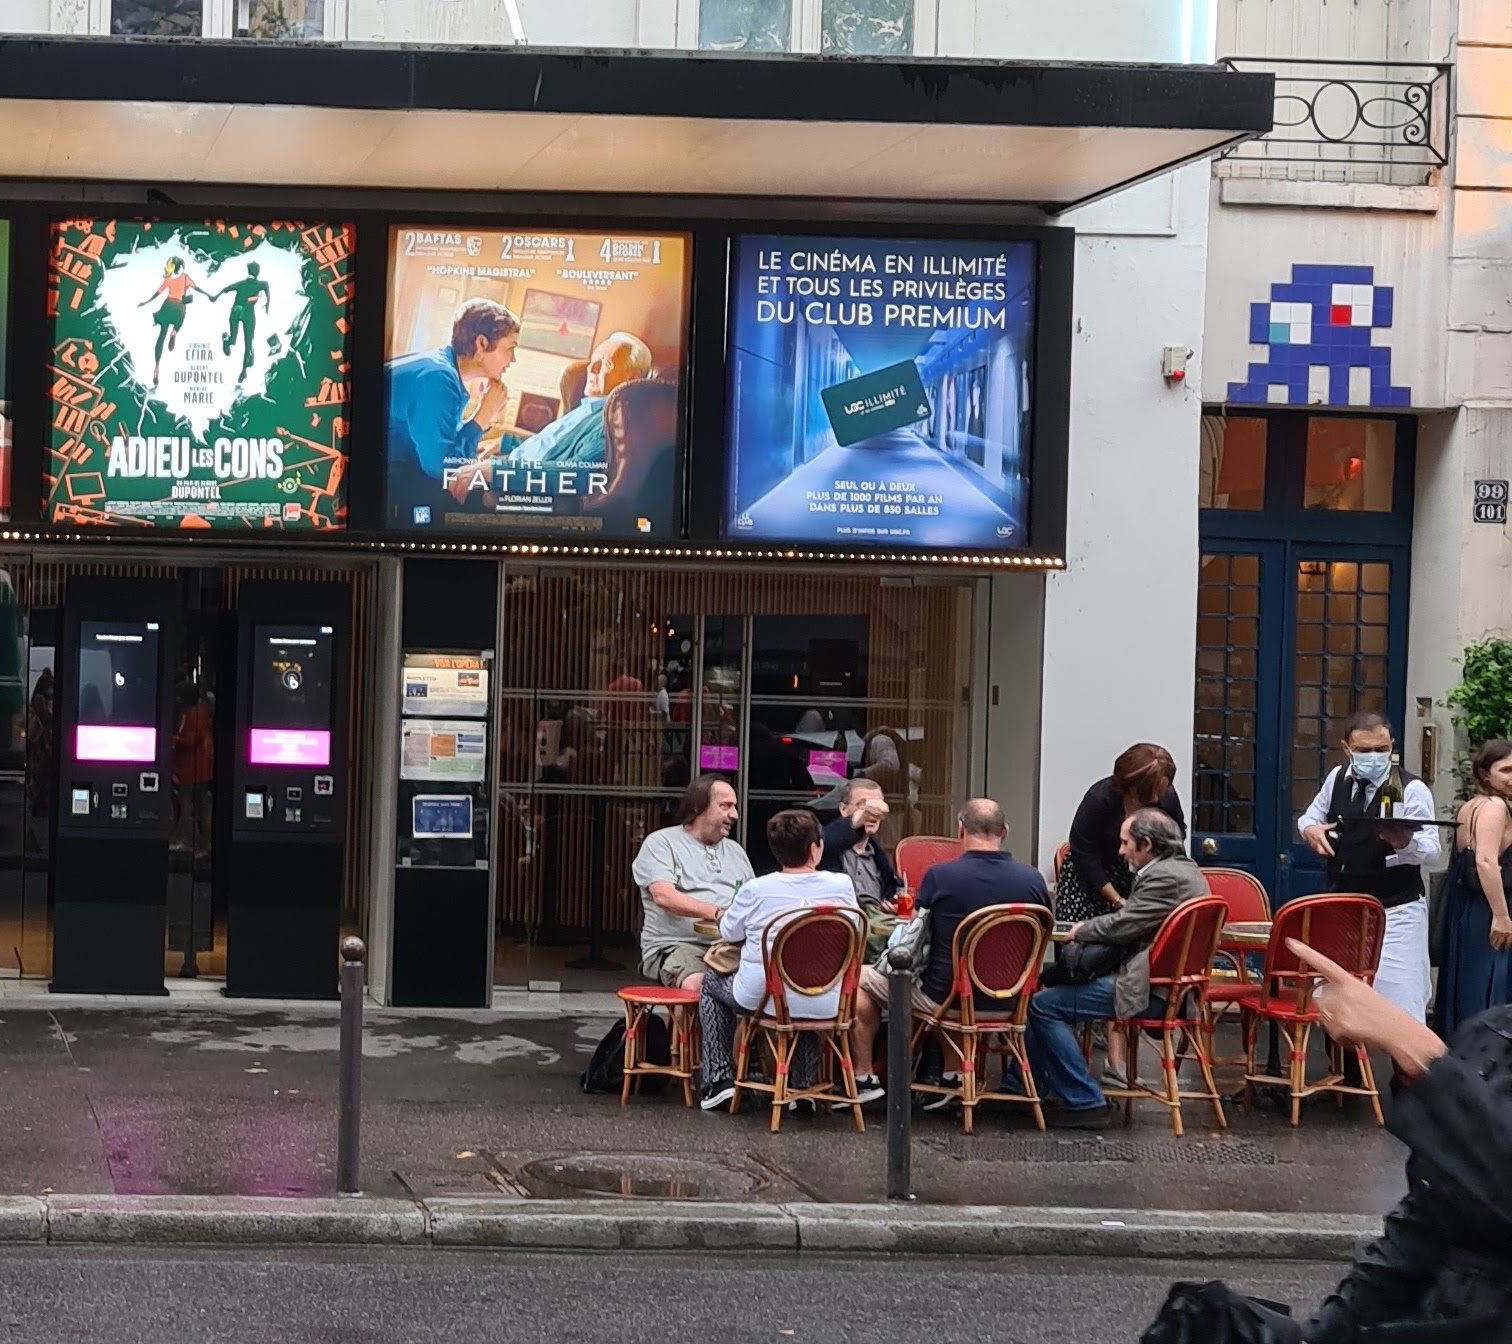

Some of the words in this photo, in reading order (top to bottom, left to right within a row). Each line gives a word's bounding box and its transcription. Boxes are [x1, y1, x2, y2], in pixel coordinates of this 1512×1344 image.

[405, 233, 416, 256] 2
[416, 233, 462, 246] BAFTAS
[501, 235, 513, 260] 2
[513, 236, 566, 249] OSCARS
[599, 239, 612, 264] 4
[427, 265, 476, 276] "HOPKINS
[759, 251, 782, 270] LE
[790, 249, 877, 273] CINÉMA
[884, 254, 913, 274] EN
[923, 254, 1007, 277] ILLIMITÉ
[556, 269, 639, 281] "BOULEVERSANT"
[758, 276, 781, 294] ET
[786, 277, 841, 296] TOUS
[850, 279, 883, 298] LES
[892, 278, 1007, 301] PRIVILÈGES
[757, 301, 794, 323] DU
[805, 301, 874, 326] CLUB
[884, 304, 1007, 330] PREMIUM
[185, 348, 214, 362] EFIRA
[174, 371, 224, 384] DUPONTEL
[844, 400, 865, 415] UGC
[864, 384, 907, 408] ILLIMITÉ
[107, 436, 190, 478] ADIEU
[191, 448, 214, 468] LES
[213, 437, 284, 479] CONS
[510, 459, 543, 470] THE
[578, 461, 608, 470] COLMAN
[442, 468, 609, 495] FATHER
[834, 480, 859, 490] SEUL
[860, 481, 876, 492] OU
[878, 479, 887, 492] À
[889, 482, 916, 493] DEUX
[171, 485, 222, 500] DUPONTEL
[805, 490, 831, 502] PLUS
[833, 492, 847, 502] DE
[850, 491, 871, 502] 1000
[874, 492, 903, 504] FILMS
[905, 493, 925, 504] PAR
[927, 494, 944, 504] AN
[1478, 484, 1504, 499] 99
[809, 502, 837, 513] DANS
[839, 503, 865, 514] PLUS
[867, 504, 881, 514] DE
[903, 505, 940, 516] SALLES
[1479, 504, 1502, 519] 101
[996, 525, 1014, 537] UGC
